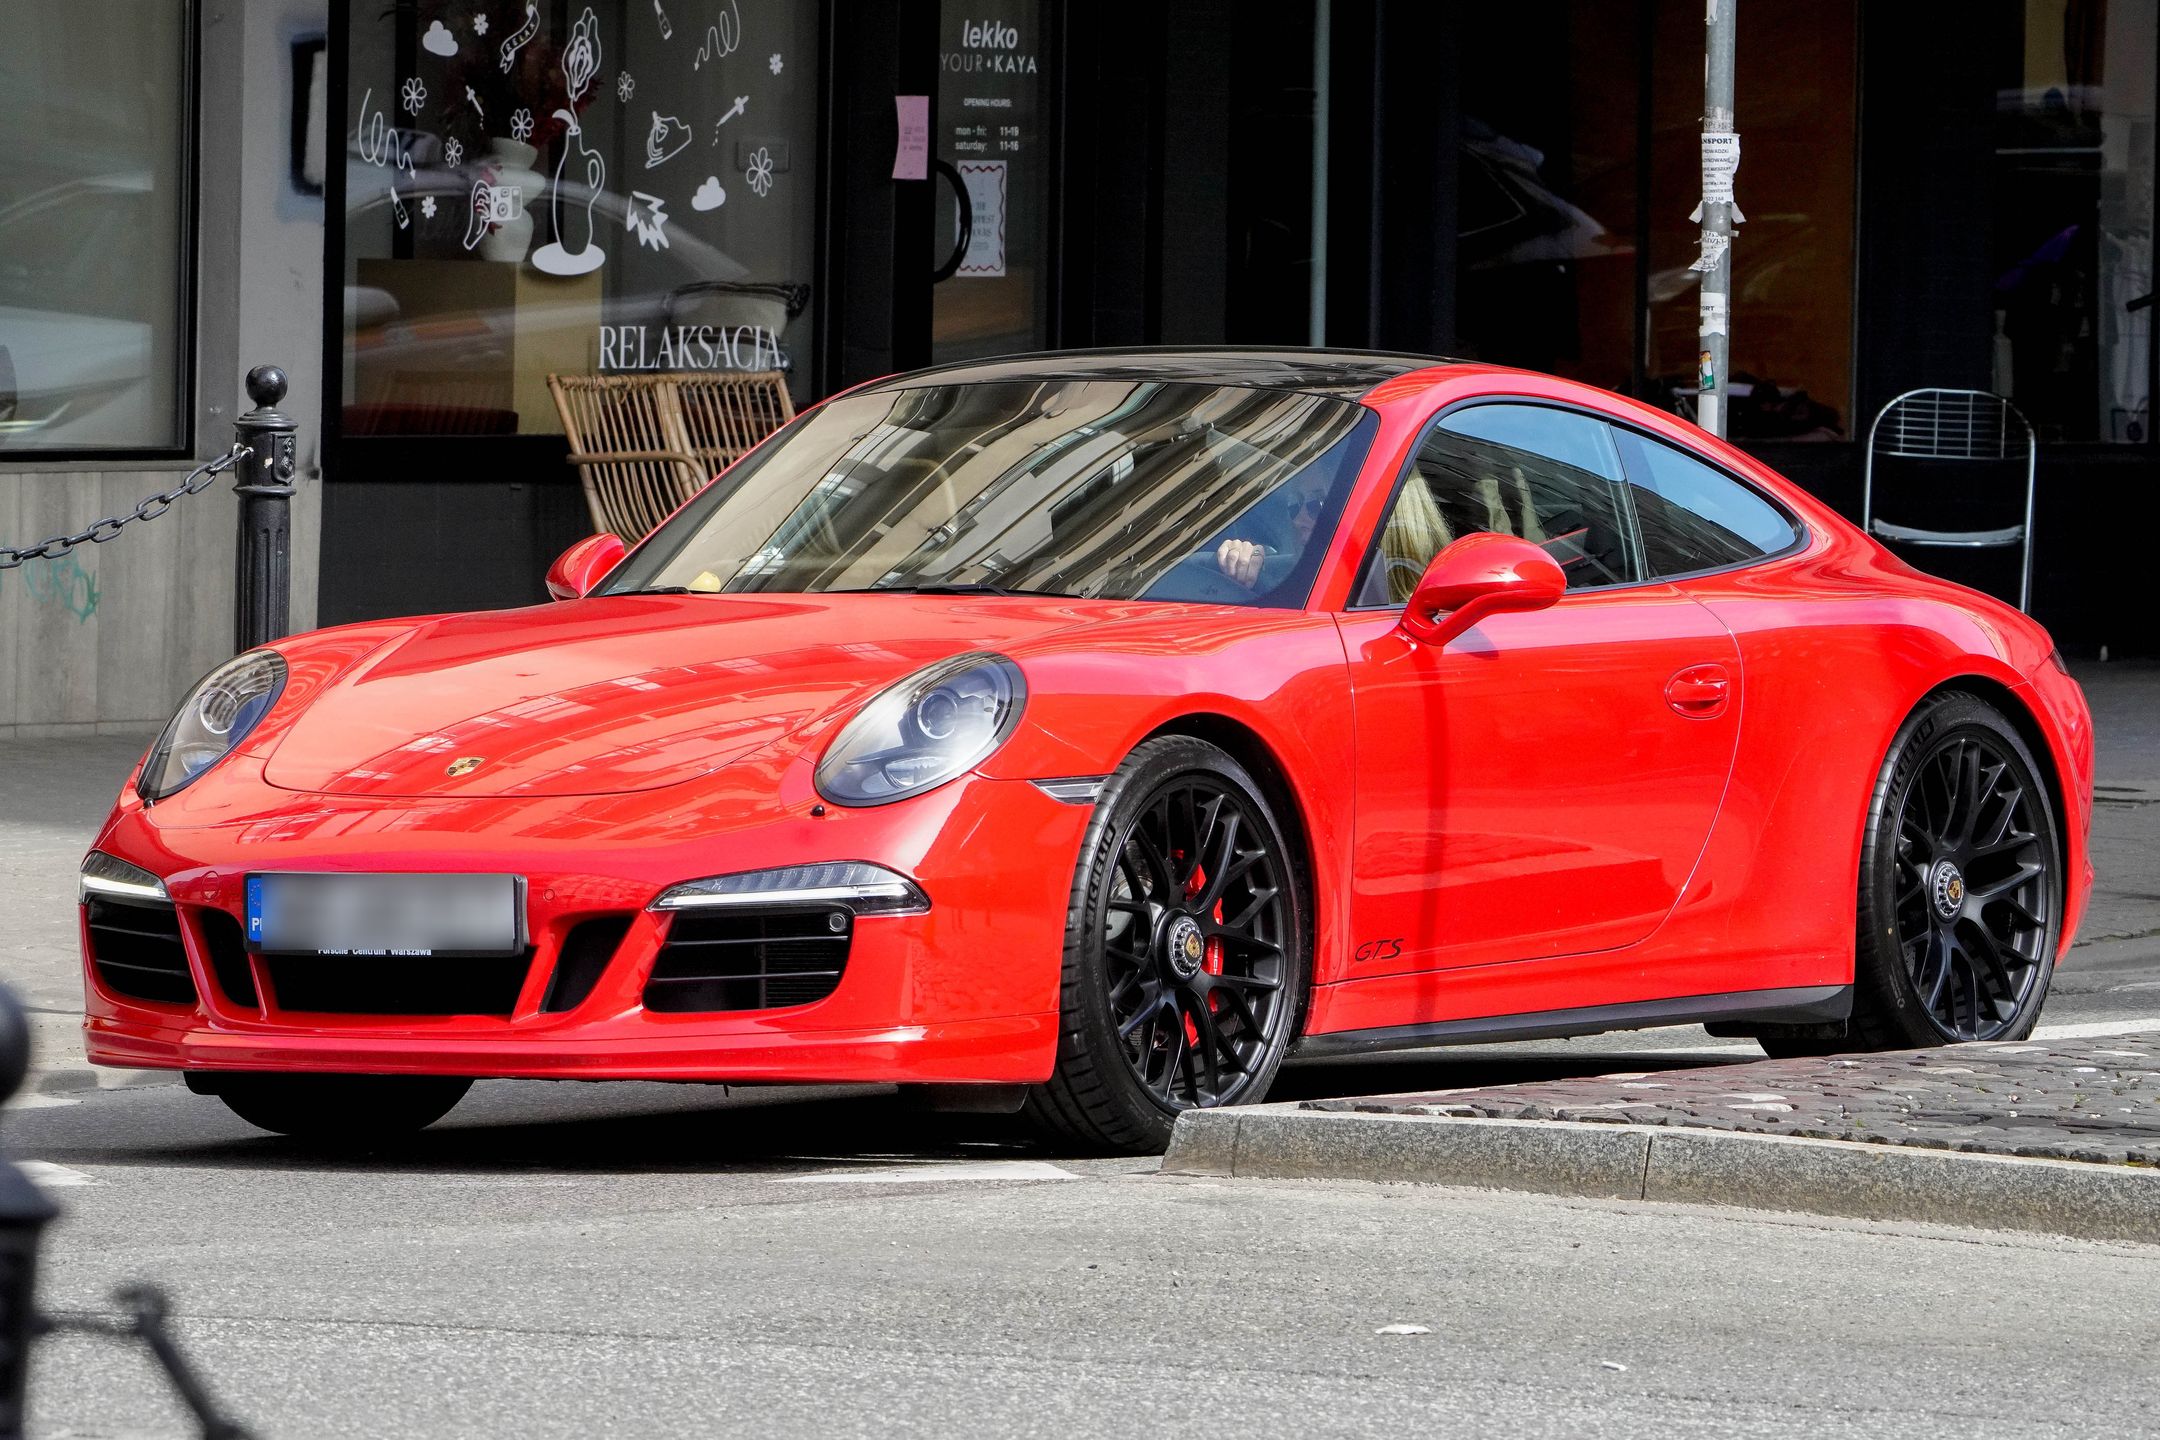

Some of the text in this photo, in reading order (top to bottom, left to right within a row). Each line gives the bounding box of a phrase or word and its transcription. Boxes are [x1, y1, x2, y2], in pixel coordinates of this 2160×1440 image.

[963, 19, 1018, 49] lekko
[940, 53, 1038, 74] YOUR KAYA
[598, 325, 789, 372] RELAKSACJA.
[1884, 717, 1935, 816] MICHELIN
[1085, 821, 1116, 932] MICHELIN
[352, 948, 386, 956] Centrum
[390, 948, 432, 957] Warszawa
[1354, 938, 1405, 962] GTS
